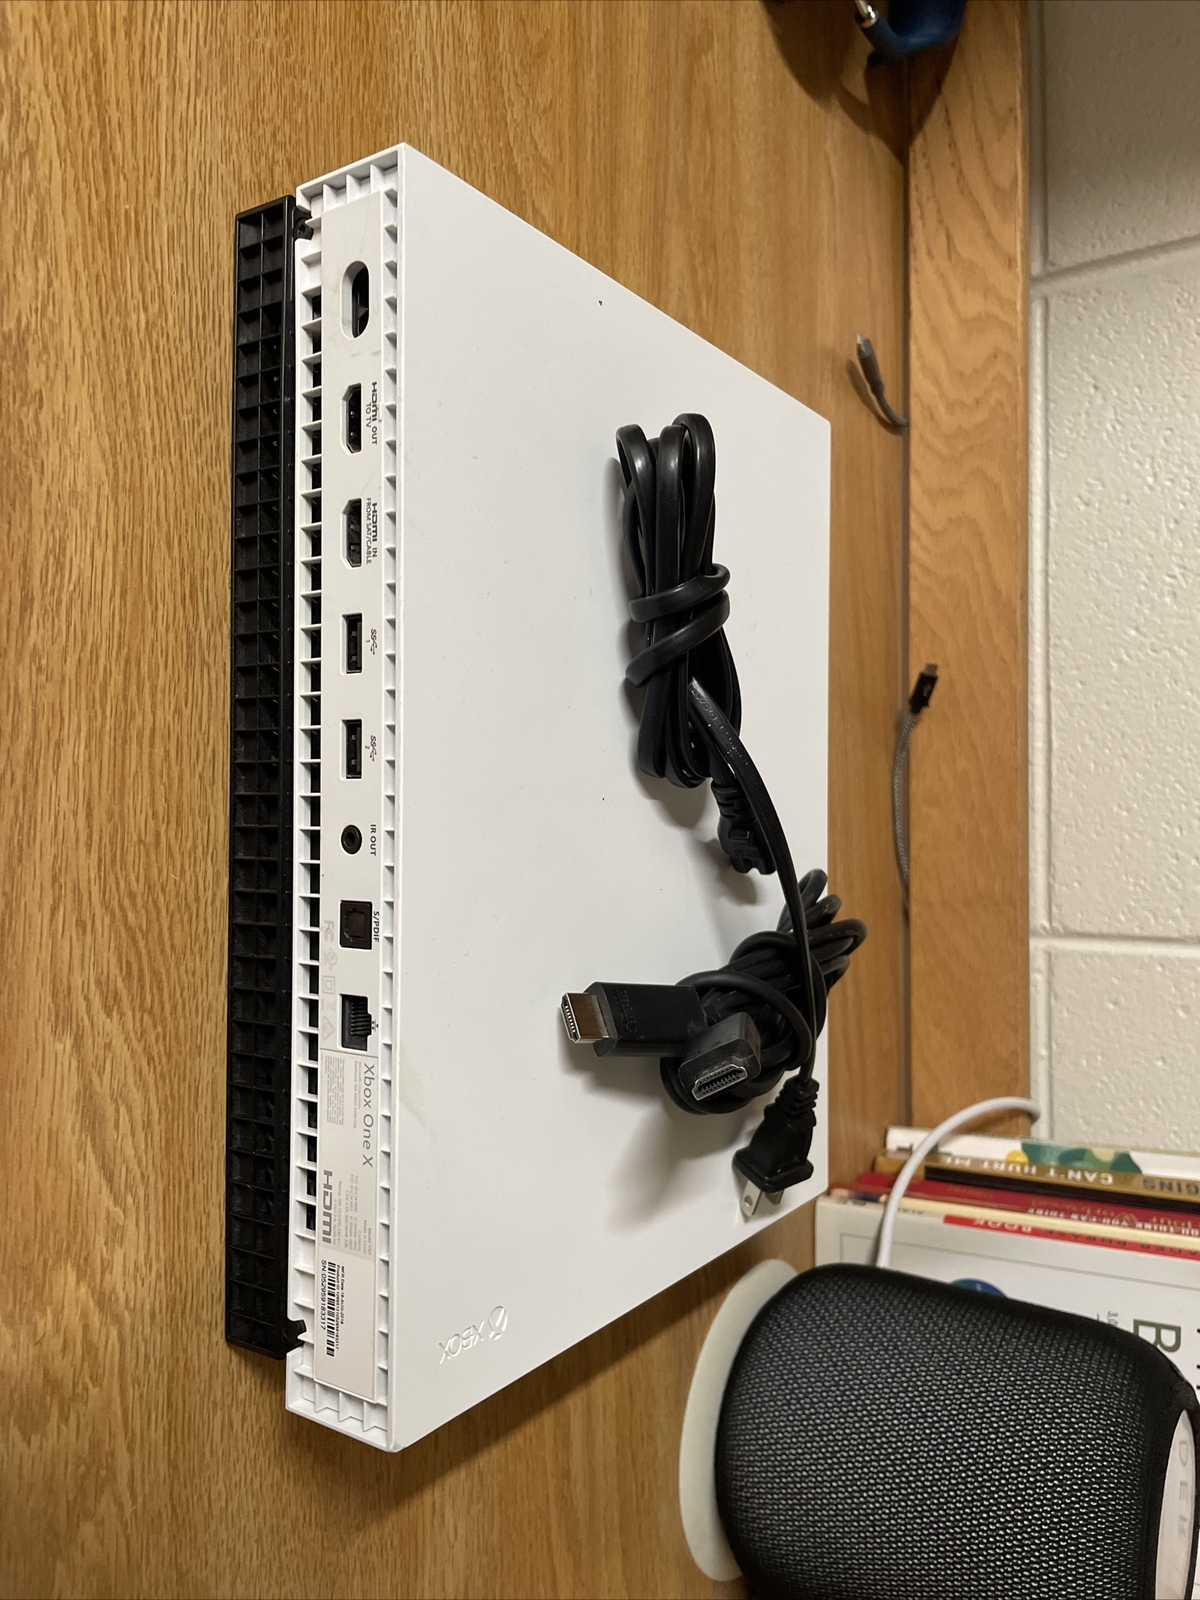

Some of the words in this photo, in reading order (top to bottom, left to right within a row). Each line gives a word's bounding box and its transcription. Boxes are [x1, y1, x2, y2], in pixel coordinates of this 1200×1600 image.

[365, 402, 371, 415] TO
[365, 417, 371, 428] TV
[371, 547, 378, 558] IN
[369, 823, 377, 834] IR
[369, 835, 377, 857] OUT
[372, 910, 380, 943] S/PDIF
[363, 1062, 375, 1109] Xbox
[362, 1113, 374, 1150] One
[362, 1154, 373, 1168] X
[982, 1160, 1037, 1175] HURT
[1049, 1166, 1114, 1186] CAN'T
[322, 1170, 333, 1243] HDMI
[438, 1320, 485, 1364] XBOX
